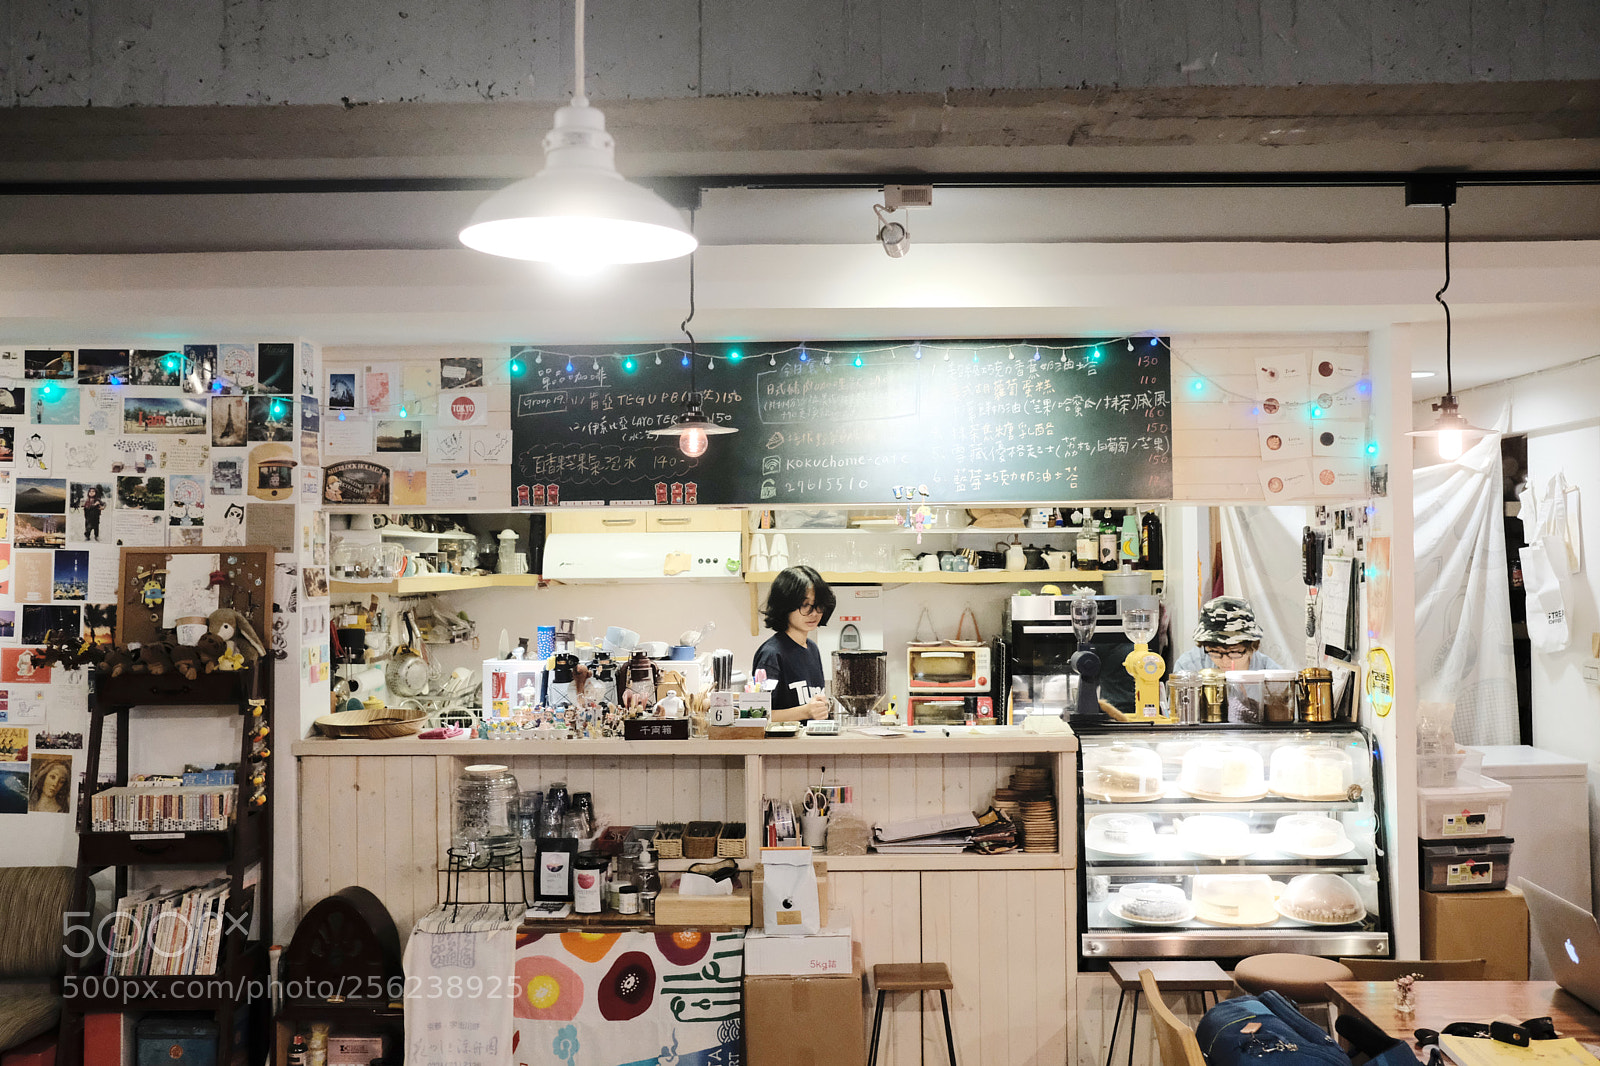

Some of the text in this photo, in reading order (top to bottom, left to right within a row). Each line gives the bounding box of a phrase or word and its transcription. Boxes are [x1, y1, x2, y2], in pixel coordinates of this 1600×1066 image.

[1138, 355, 1159, 367] 130
[1139, 375, 1157, 385] 110
[617, 394, 657, 406] TEGU
[452, 404, 474, 412] TOKYO
[1144, 407, 1165, 418] 160
[1146, 423, 1168, 434] 150
[1148, 454, 1168, 464] 150
[715, 709, 723, 721] 6
[183, 774, 233, 786] 富士山
